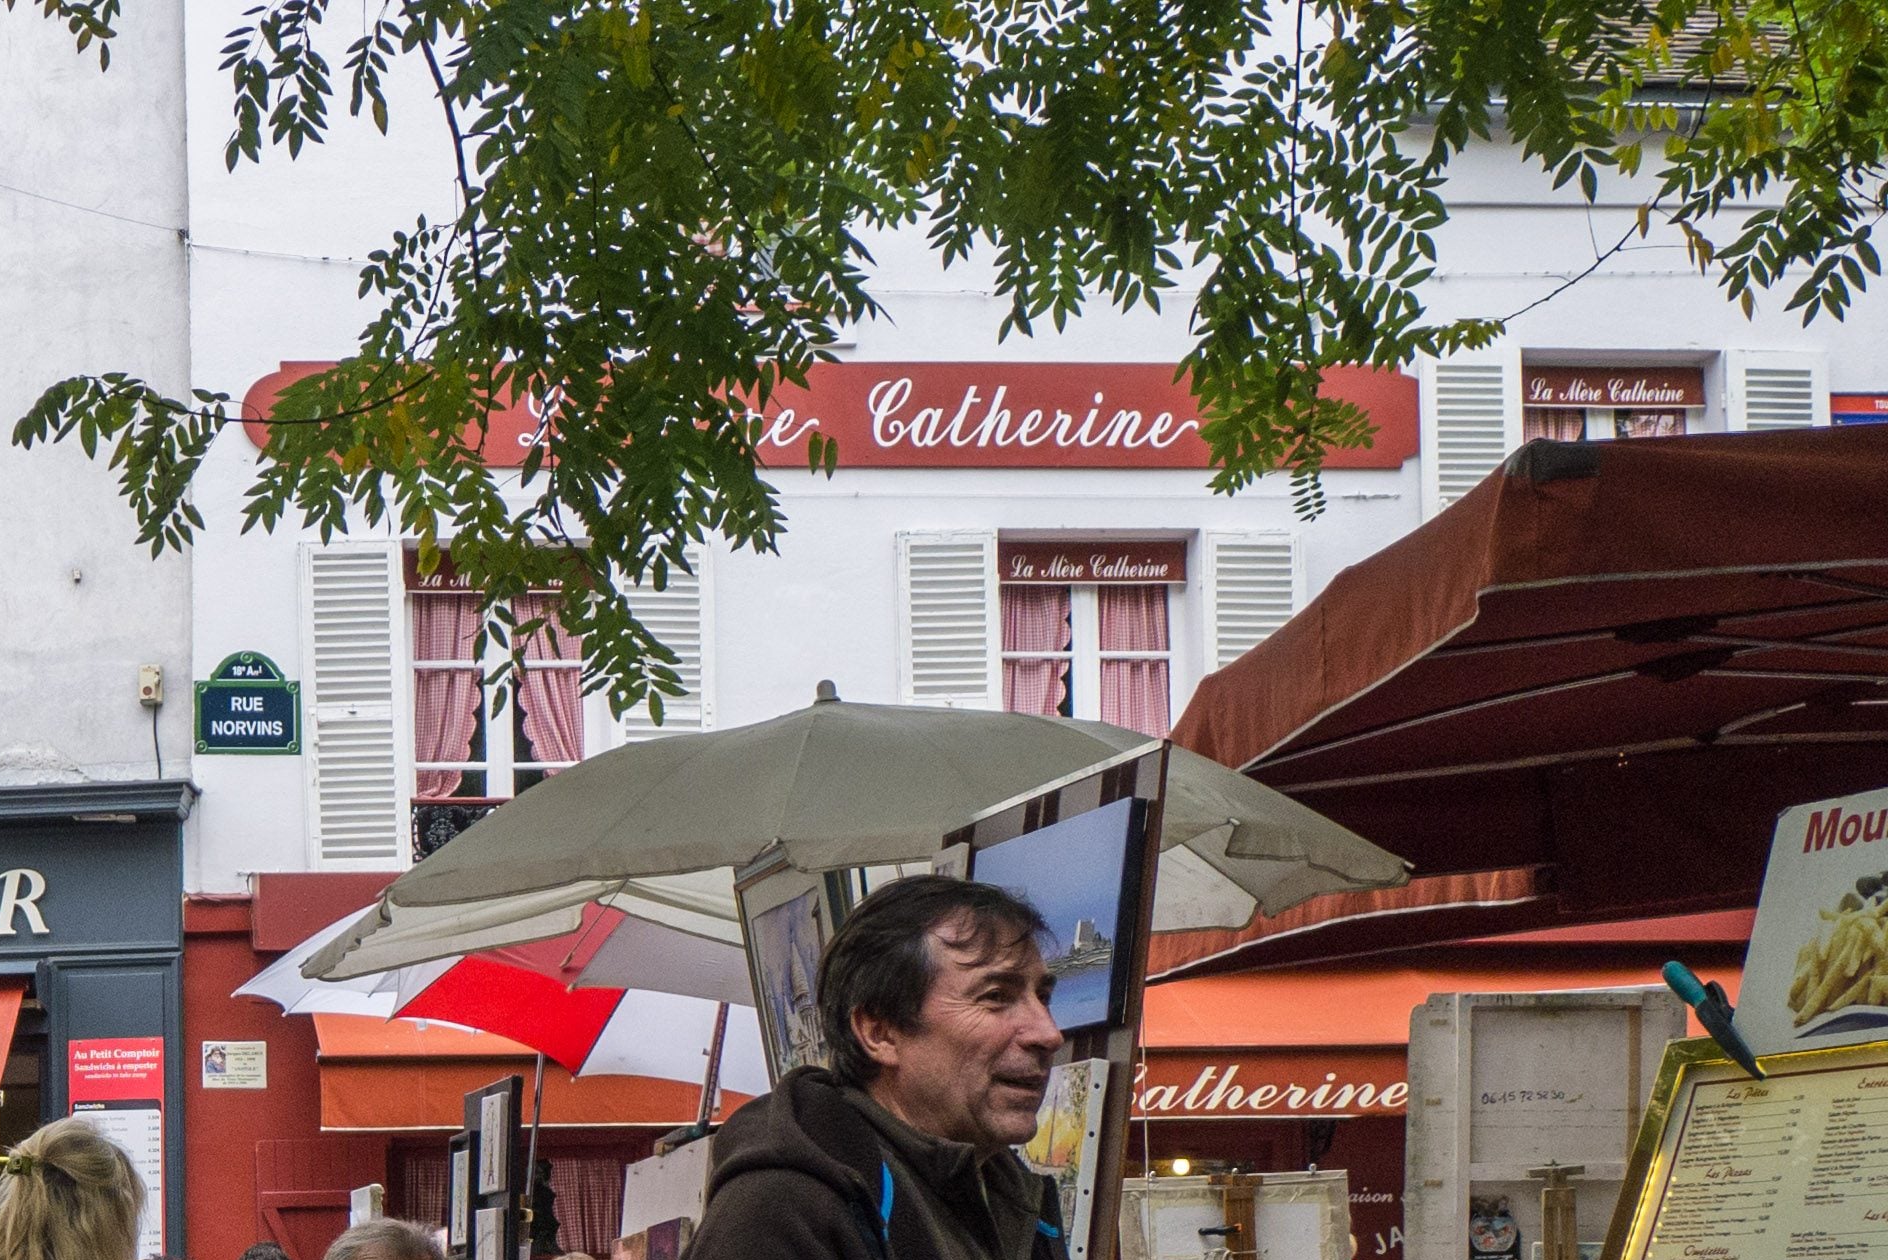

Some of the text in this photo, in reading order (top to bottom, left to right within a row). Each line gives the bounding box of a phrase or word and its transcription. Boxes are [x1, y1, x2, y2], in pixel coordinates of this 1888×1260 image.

[1530, 377, 1685, 402] La Mère Catherine
[869, 377, 1201, 449] Catherine
[1011, 554, 1169, 578] La Mère Catherine
[231, 697, 264, 712] RUE
[211, 720, 284, 736] NORVINS
[1803, 807, 1888, 854] Mou
[74, 1048, 161, 1060] Au Petit Comptoir
[122, 1062, 158, 1072] emporter
[1723, 1166, 1753, 1180] Pizzas
[1348, 1187, 1393, 1204] aison
[1683, 1245, 1730, 1257] Omelettes
